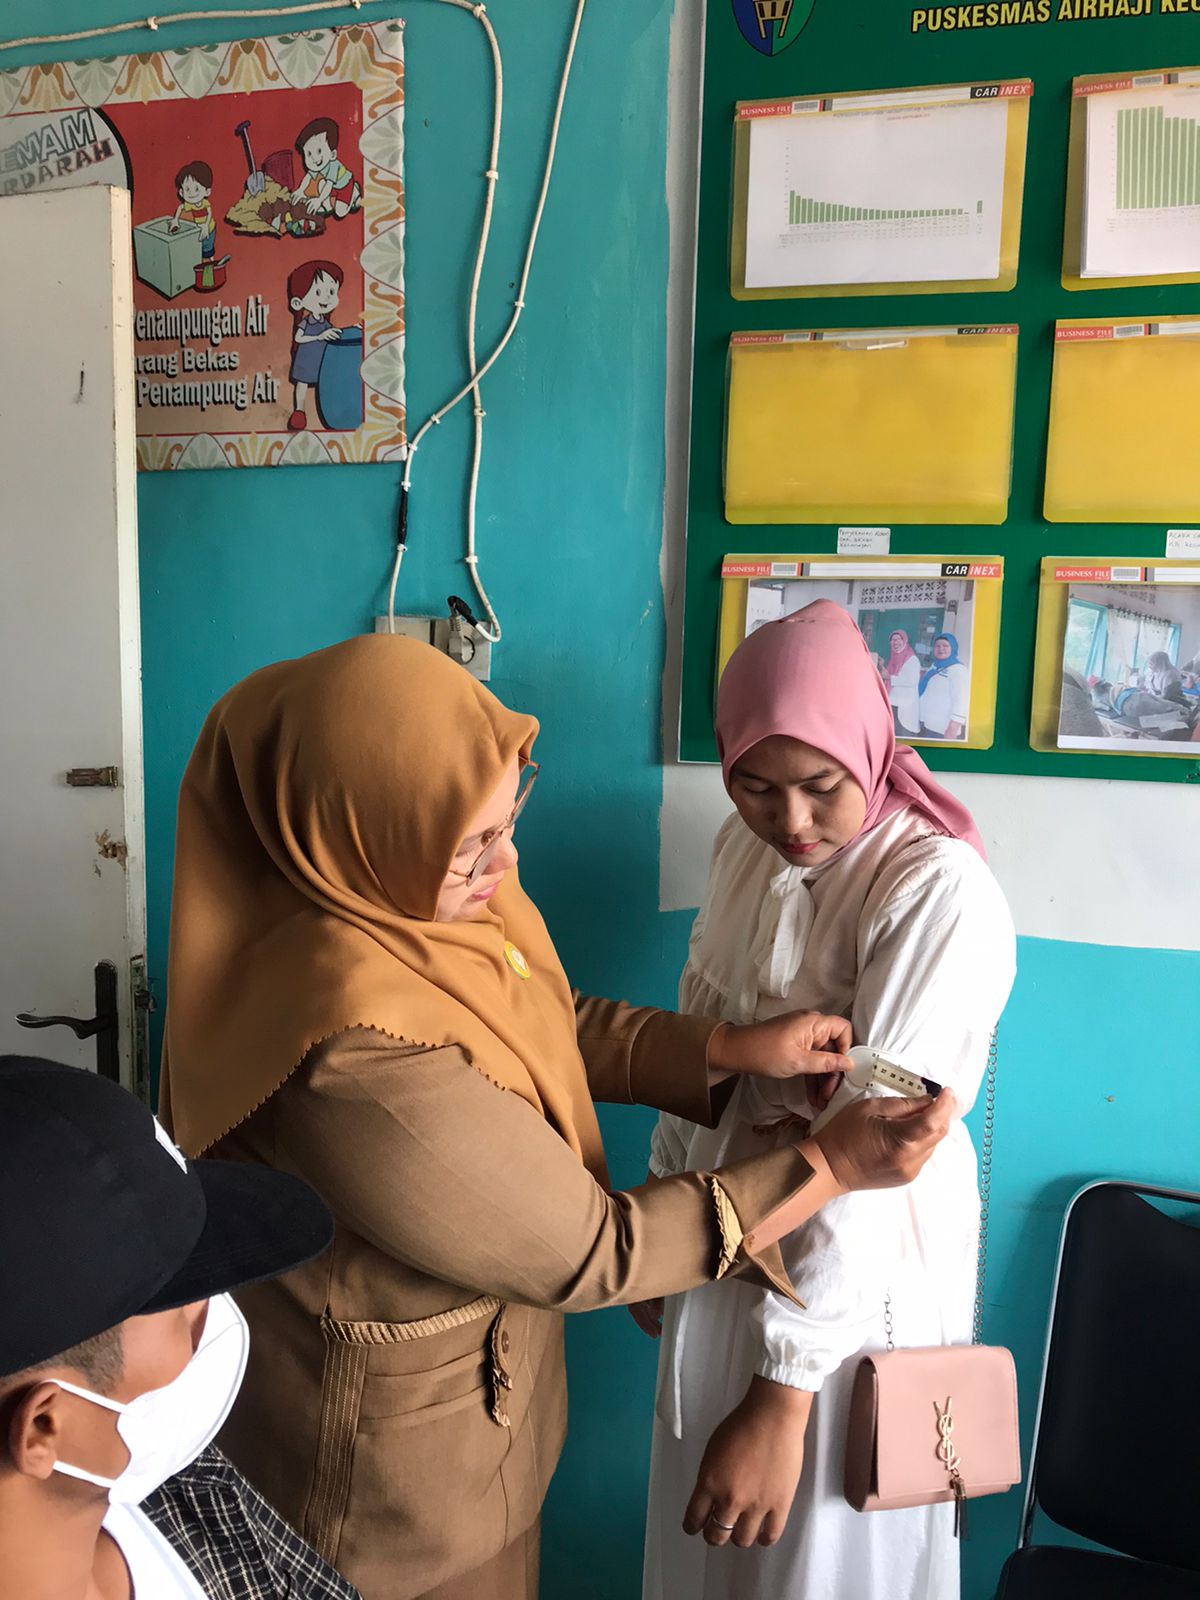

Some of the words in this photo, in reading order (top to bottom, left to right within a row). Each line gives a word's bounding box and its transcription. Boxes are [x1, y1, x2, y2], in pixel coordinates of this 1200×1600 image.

[911, 0, 1051, 33] PUSKESMAS
[1057, 0, 1152, 20] AIRHAJI
[1074, 82, 1113, 94] BUSINESS
[740, 107, 775, 116] BUSINESS
[776, 105, 791, 113] FILE
[133, 300, 241, 347] enampungan
[244, 294, 270, 337] Air
[1056, 329, 1095, 338] BUSINESS
[1096, 328, 1112, 336] FILE
[182, 347, 240, 373] Bekas
[136, 374, 248, 411] Penampung
[252, 371, 281, 404] Air
[721, 565, 756, 574] BUSINESS
